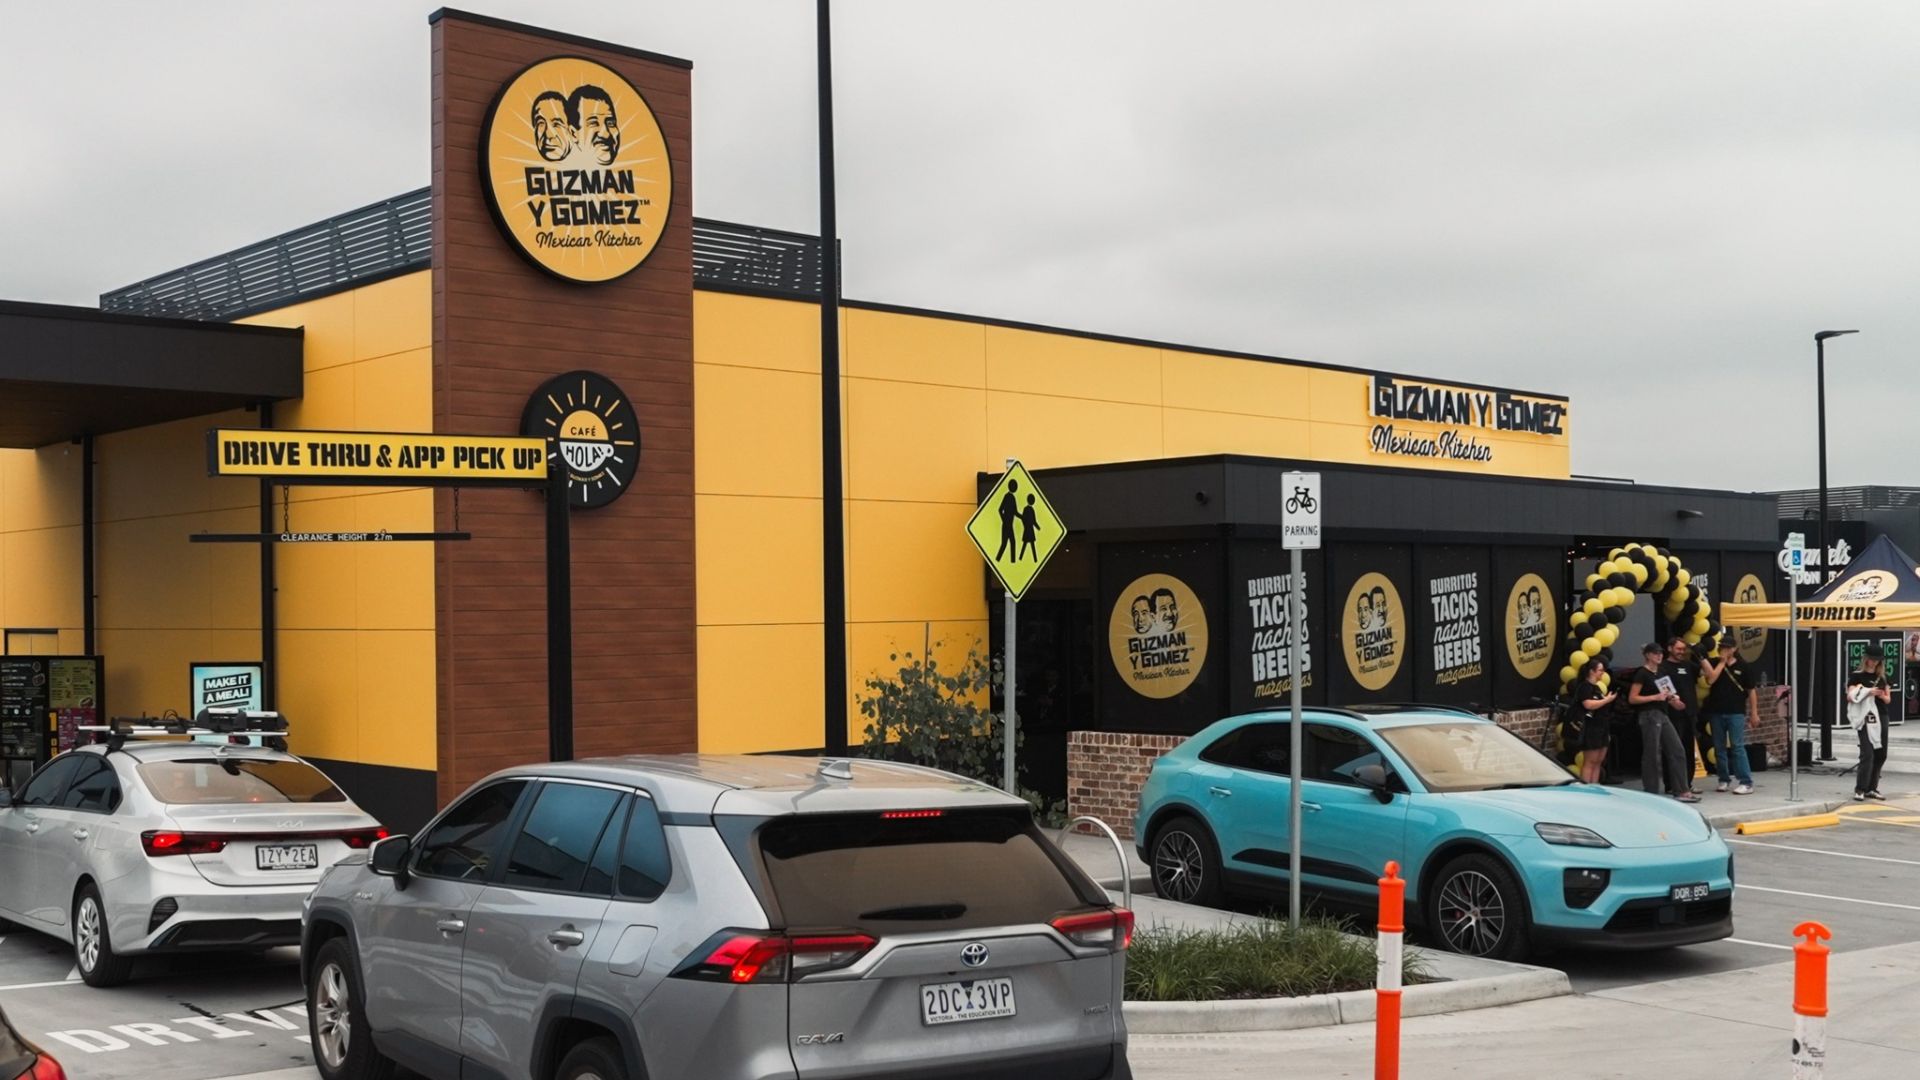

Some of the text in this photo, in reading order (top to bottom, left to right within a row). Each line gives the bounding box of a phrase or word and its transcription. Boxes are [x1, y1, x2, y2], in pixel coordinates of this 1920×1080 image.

[524, 166, 635, 196] GUZMAN
[527, 200, 546, 227] Y
[535, 230, 643, 248] Mexican Kitchen
[1371, 377, 1470, 426] GUZMAN
[1474, 392, 1490, 428] Y
[570, 425, 597, 437] CAFÉ
[1371, 424, 1493, 462] Mexican Kitchen
[223, 441, 542, 470] DRIVE THRU & APP PICK UP
[280, 533, 393, 542] CLEARANCE HEIGHT 2.7m
[1284, 525, 1318, 536] PARKING
[1248, 571, 1307, 598] BURRITS
[1430, 572, 1477, 595] BURRITOS
[1431, 589, 1479, 623] TACOS
[1252, 619, 1309, 652] nachs
[1355, 627, 1392, 648] GUZMAN
[1433, 615, 1480, 644] nachos
[1515, 622, 1546, 642] GUZMAN
[1128, 632, 1187, 654] GUZMAN
[1433, 636, 1481, 671] BEERS
[1850, 644, 1866, 657] ICE
[1883, 643, 1899, 656] ICE
[1129, 655, 1139, 670] Y
[1252, 643, 1311, 682] BEES
[1356, 650, 1363, 664] Y
[205, 675, 249, 689] MAKE IT
[1435, 662, 1482, 685] margaritas
[1254, 673, 1312, 698] margaas
[206, 693, 215, 703] A
[261, 847, 316, 864] 1ZY 2EA
[925, 982, 1010, 1015] 2DC 3VP
[930, 1014, 953, 1022] VICTORIA
[968, 1010, 996, 1018] EDUCATION
[796, 1031, 844, 1046] RAV4
